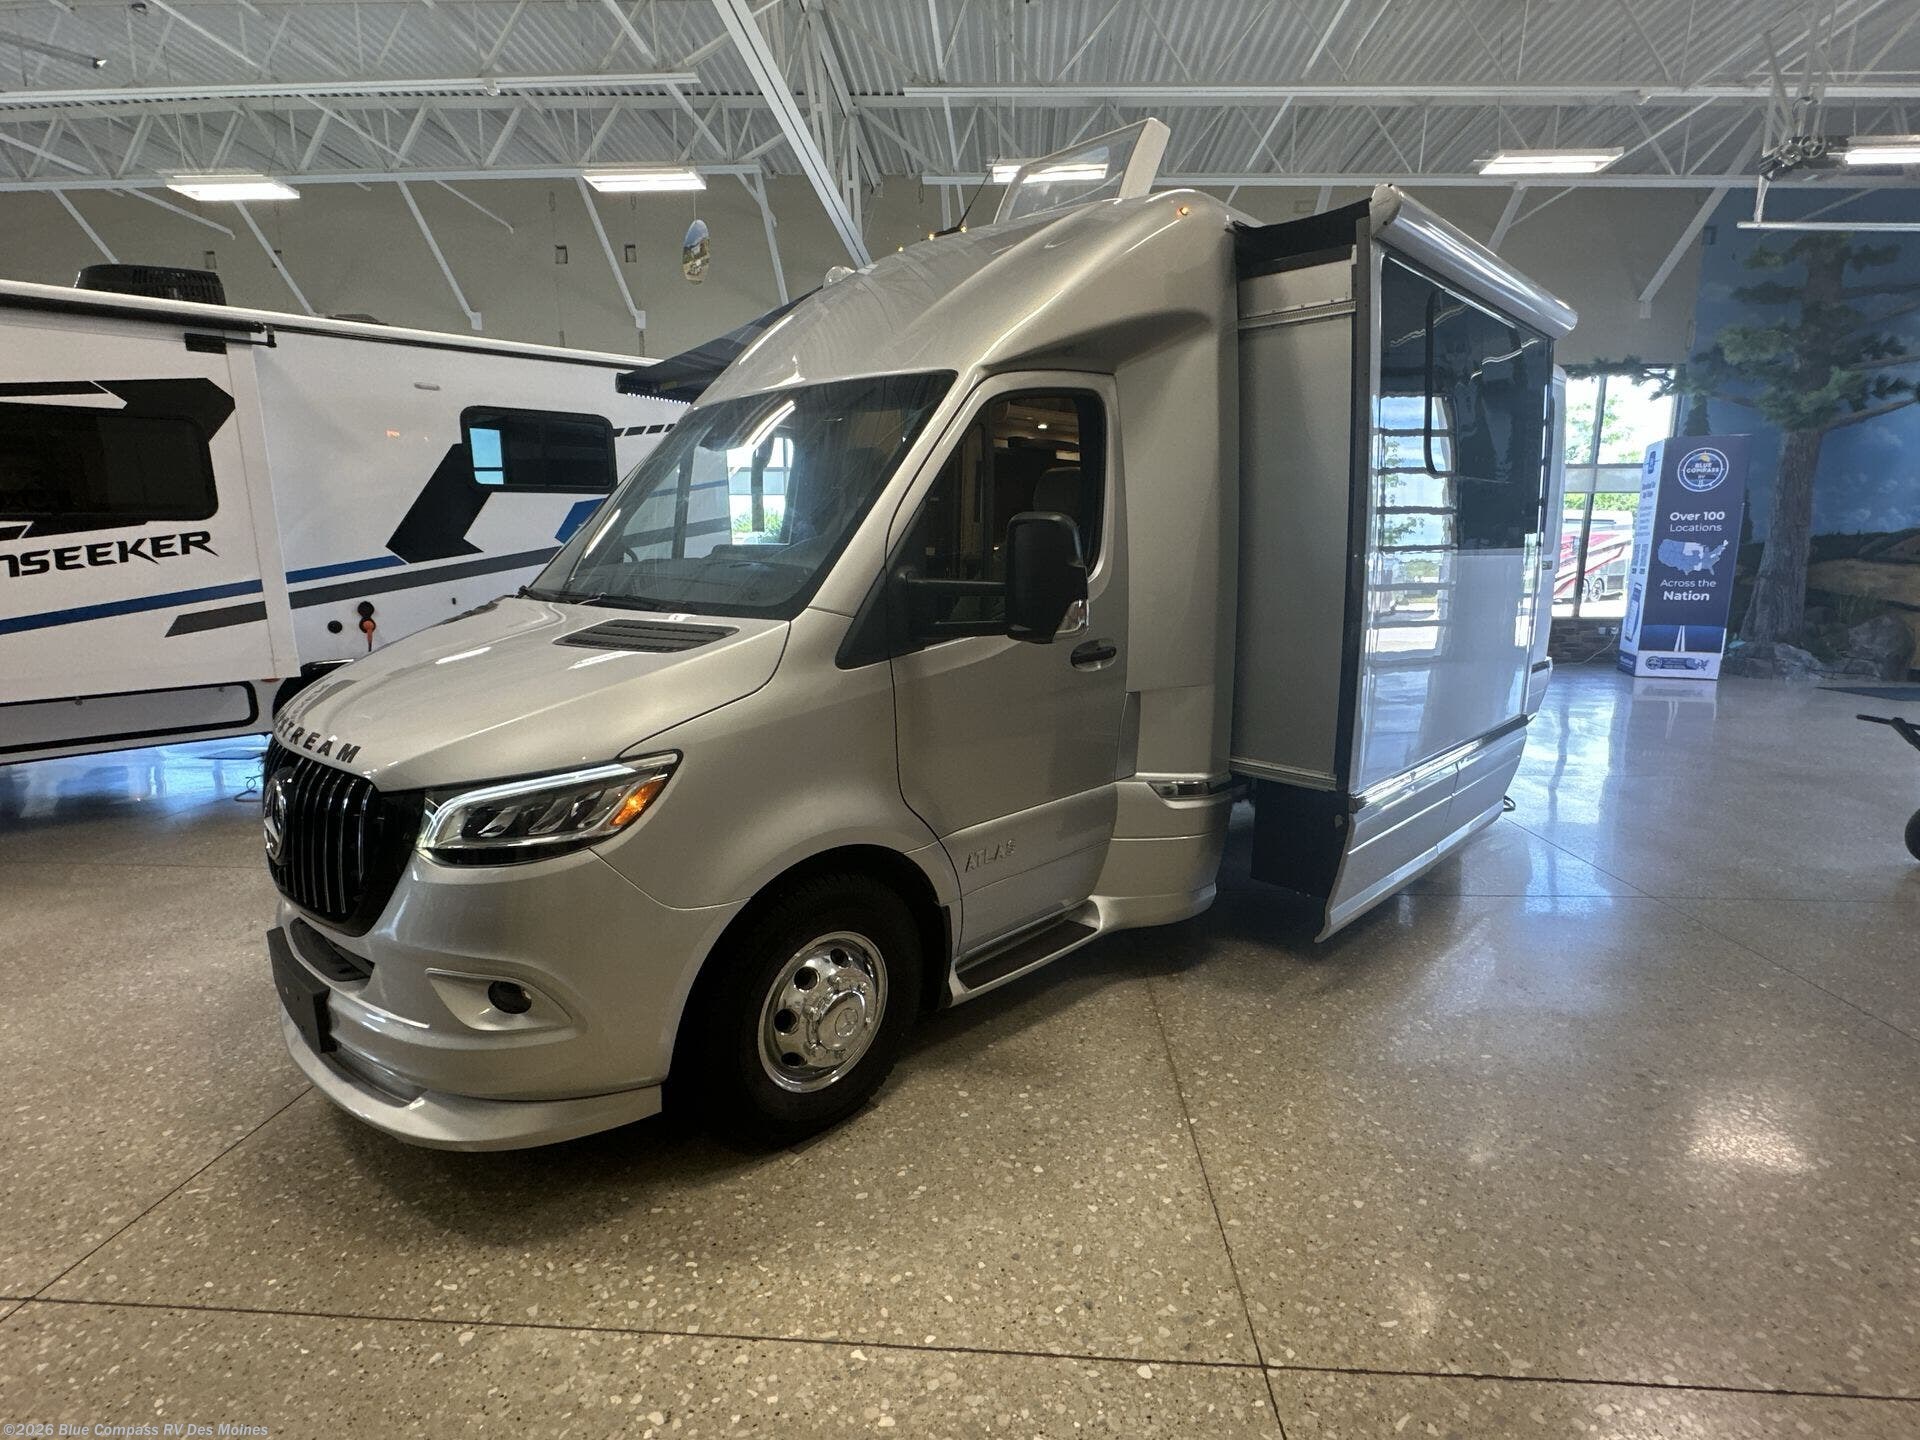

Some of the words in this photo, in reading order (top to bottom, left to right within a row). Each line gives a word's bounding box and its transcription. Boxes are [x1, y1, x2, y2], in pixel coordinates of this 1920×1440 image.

[1670, 512, 1700, 521] Over
[1703, 511, 1725, 520] 100
[1670, 523, 1722, 532] Locations
[1660, 579, 1696, 588] Across
[1697, 579, 1717, 588] the
[1663, 590, 1710, 601] Nation
[965, 839, 1016, 873] ATLAS
